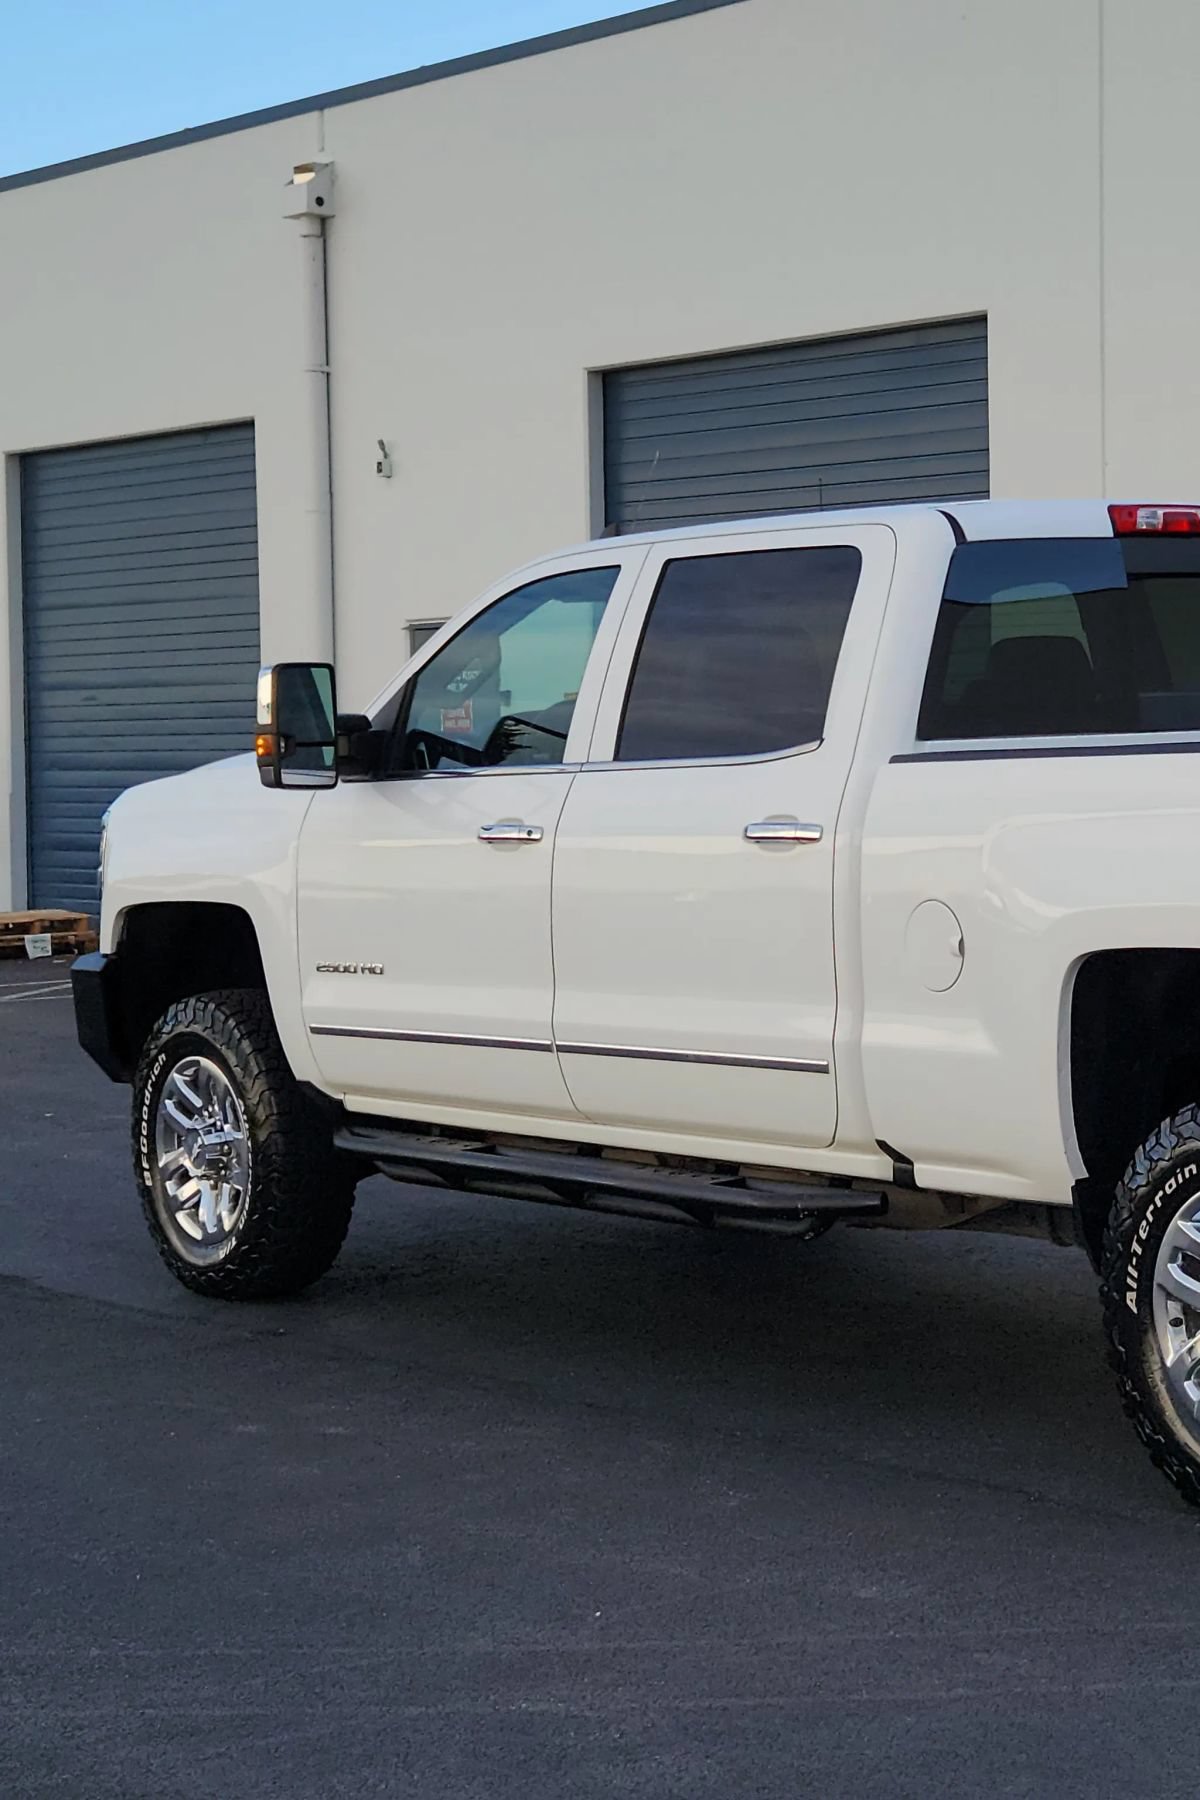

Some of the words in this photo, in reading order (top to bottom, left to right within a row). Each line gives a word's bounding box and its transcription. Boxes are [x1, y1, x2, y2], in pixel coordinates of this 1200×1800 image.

[316, 961, 357, 974] 2500
[360, 962, 384, 975] HD
[140, 1053, 167, 1187] BFGoodrich
[1126, 1163, 1197, 1315] All-Terrain
